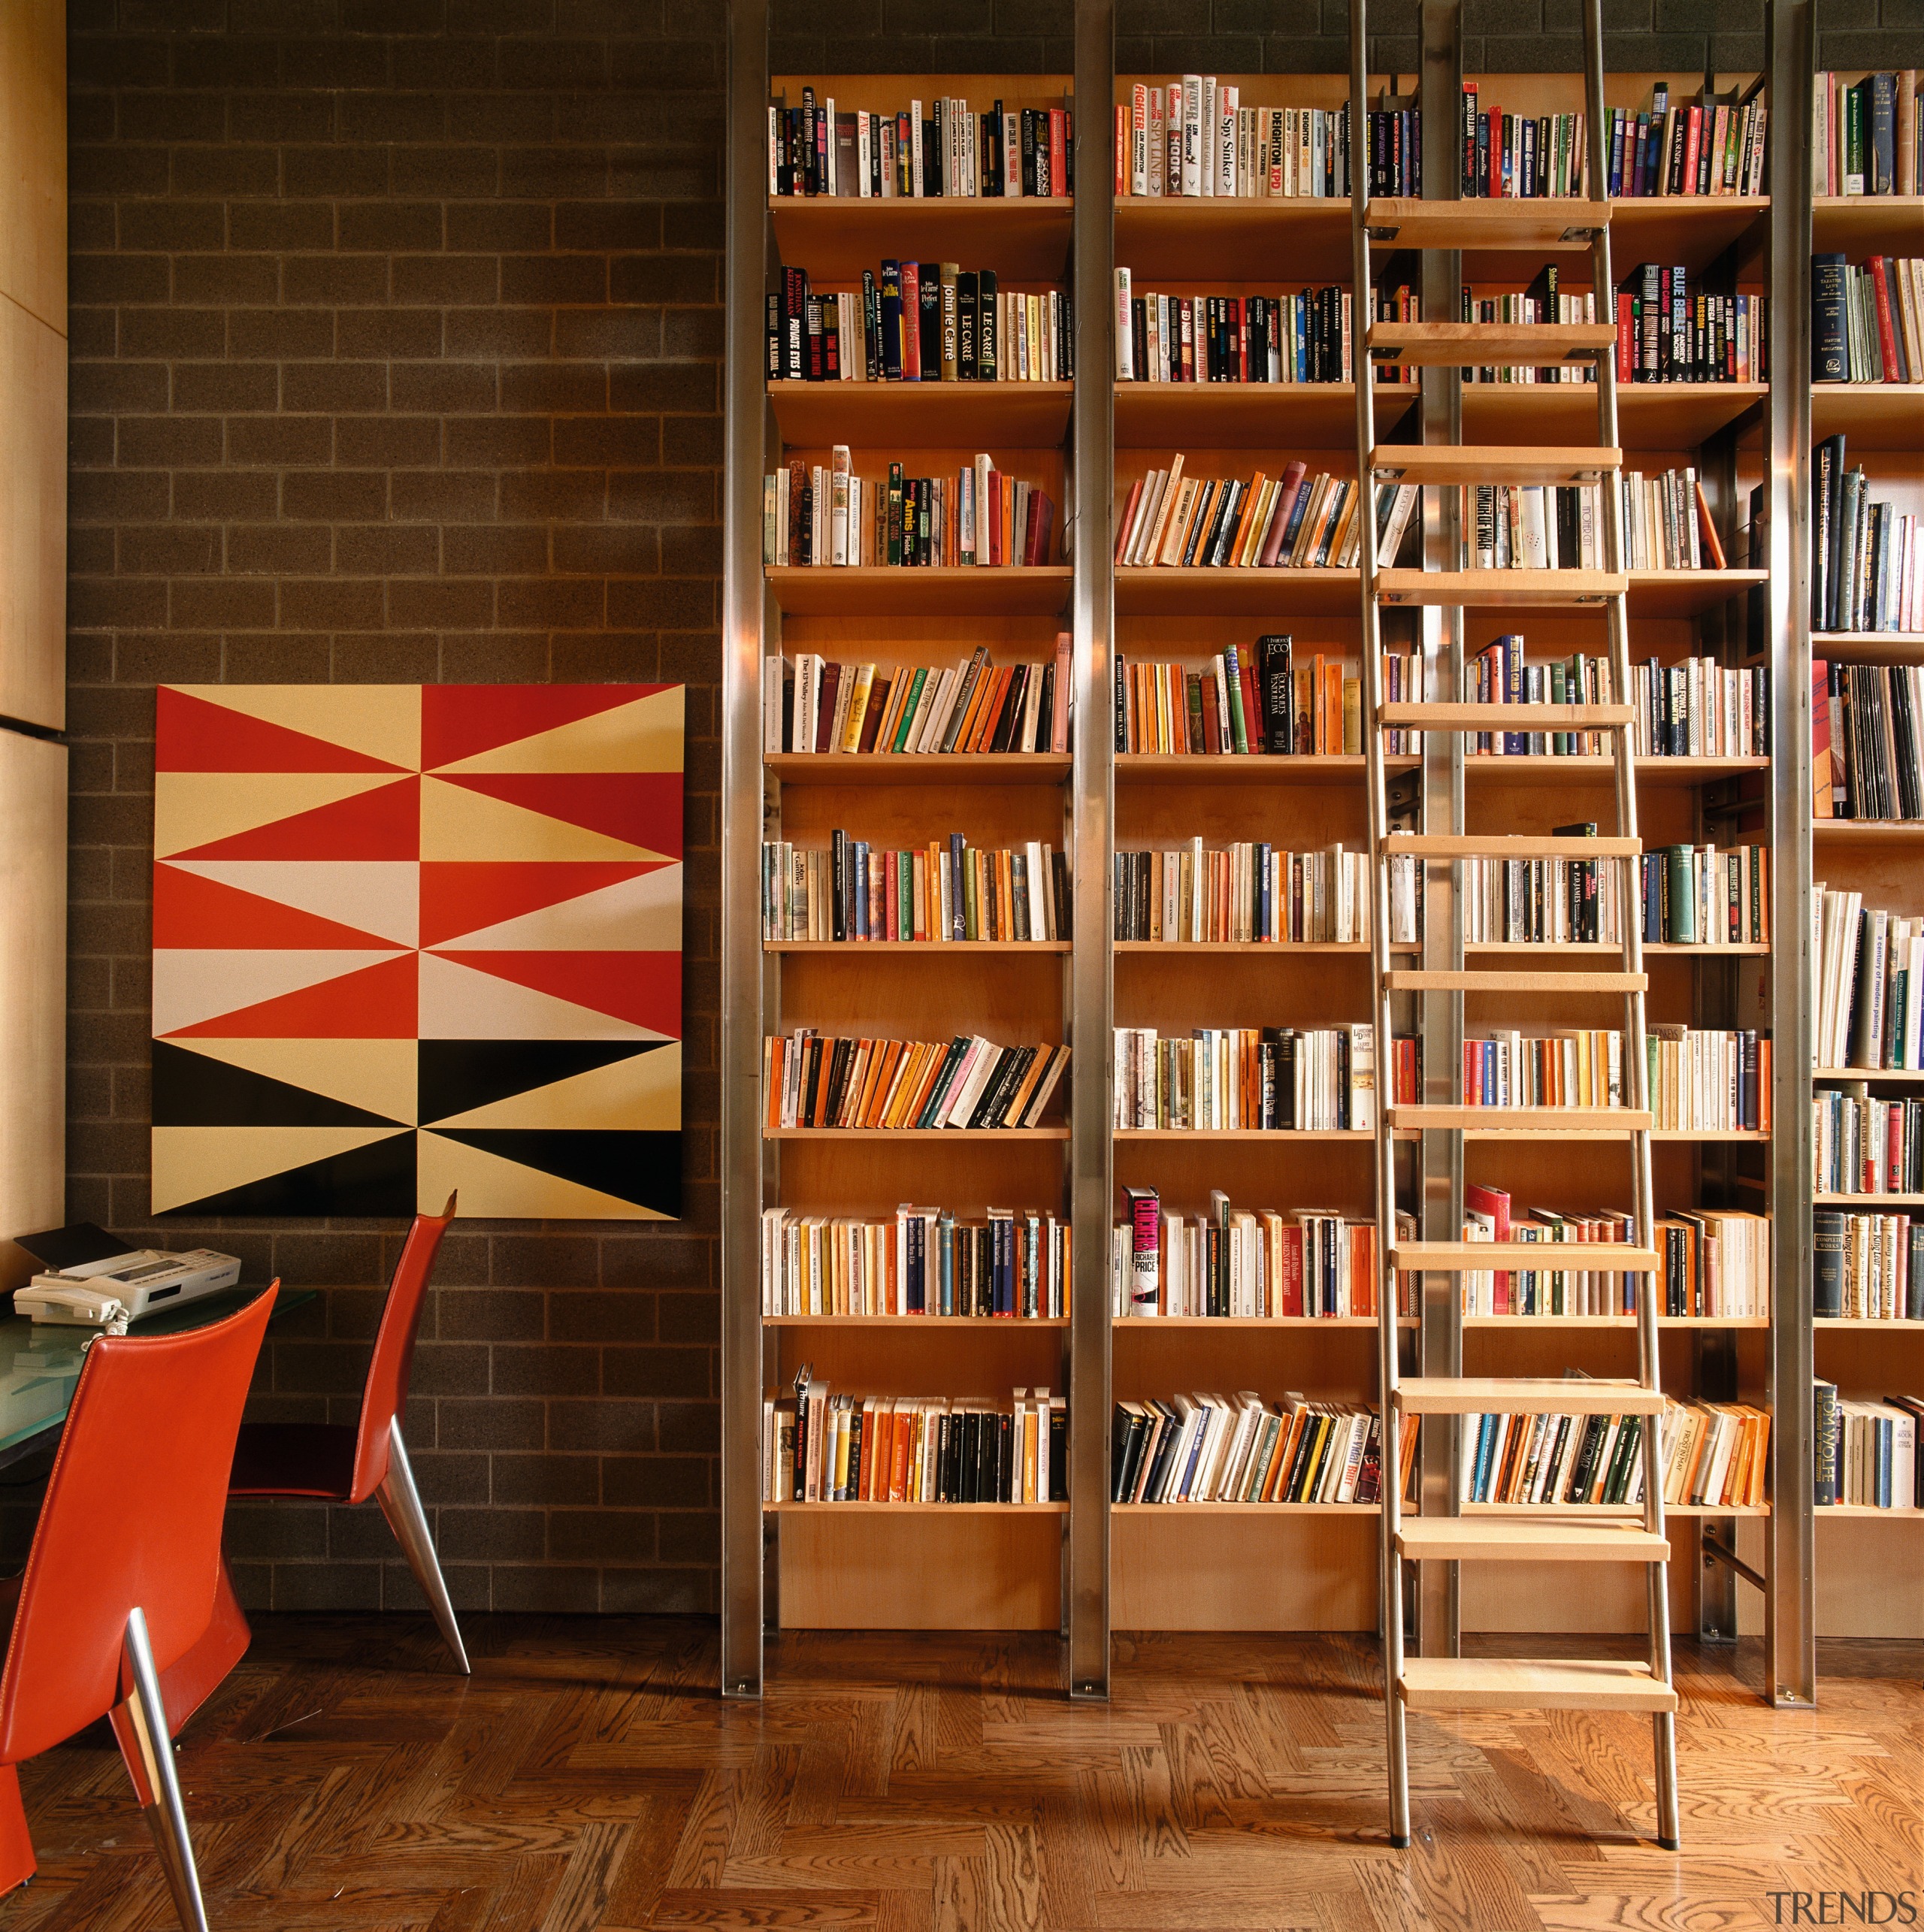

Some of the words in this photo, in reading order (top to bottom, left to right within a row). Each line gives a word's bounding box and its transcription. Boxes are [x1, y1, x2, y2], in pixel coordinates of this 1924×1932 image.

[803, 92, 812, 101] MY
[1135, 85, 1145, 130] FIGHTER
[1186, 80, 1199, 120] WINTER
[804, 101, 812, 116] DEAD
[804, 118, 813, 142] BROTHER
[1024, 116, 1033, 155] POSTMORTEM
[1151, 121, 1161, 146] SPY
[1221, 118, 1233, 138] Spy
[1272, 112, 1281, 165] DEIGHTON
[1674, 125, 1684, 143] BLACK
[1204, 142, 1210, 152] OF
[1674, 144, 1682, 165] SUNDAY
[1009, 159, 1017, 169] FROM
[1151, 148, 1161, 178] LINE
[1223, 141, 1233, 179] Sinker
[1271, 168, 1281, 189] XPD
[863, 273, 872, 295] Green
[1673, 267, 1685, 296] BLUE
[769, 296, 777, 308] BAD
[864, 296, 873, 311] with
[906, 293, 916, 322] Russia
[942, 285, 955, 311] John
[769, 310, 777, 331] MONEY
[808, 304, 821, 335] KELLERMAN
[945, 315, 954, 325] le
[962, 315, 972, 329] LE
[983, 312, 992, 325] LE
[1673, 299, 1685, 333] BELLE
[790, 319, 800, 349] PRIVATE
[827, 335, 836, 350] TIME
[906, 324, 916, 355] House
[945, 328, 955, 361] Carré
[983, 327, 994, 358] CARRÉ
[963, 330, 973, 361] CARRÉ
[790, 351, 800, 369] EYES
[827, 352, 836, 370] BOMB
[905, 499, 915, 531] Amis
[1478, 516, 1492, 528] OF
[1582, 506, 1591, 533] ANOTHER
[1478, 528, 1492, 550] WAR
[1583, 535, 1592, 547] CITY
[1268, 643, 1289, 654] ECO
[921, 681, 935, 709] RAGTIME
[1278, 673, 1287, 715] FOUCAULT'S
[1871, 1009, 1880, 1039] painting
[1134, 1200, 1157, 1251] CLOCKERS
[1282, 1229, 1290, 1257] CHILDREN
[1842, 1235, 1853, 1251] King
[1871, 1235, 1881, 1251] King
[1135, 1262, 1157, 1272] PRICE
[1282, 1265, 1290, 1277] THE
[1290, 1262, 1299, 1280] Rybakov
[1283, 1277, 1291, 1296] ARBAT
[799, 1390, 808, 1416] Perfume
[1823, 1391, 1835, 1425] TOM
[1355, 1419, 1367, 1441] Gore
[1681, 1430, 1691, 1448] FROST
[1349, 1441, 1363, 1463] Vidal
[1823, 1428, 1835, 1482] WOLFE
[1676, 1457, 1685, 1471] MAY
[1345, 1465, 1357, 1487] Burr
